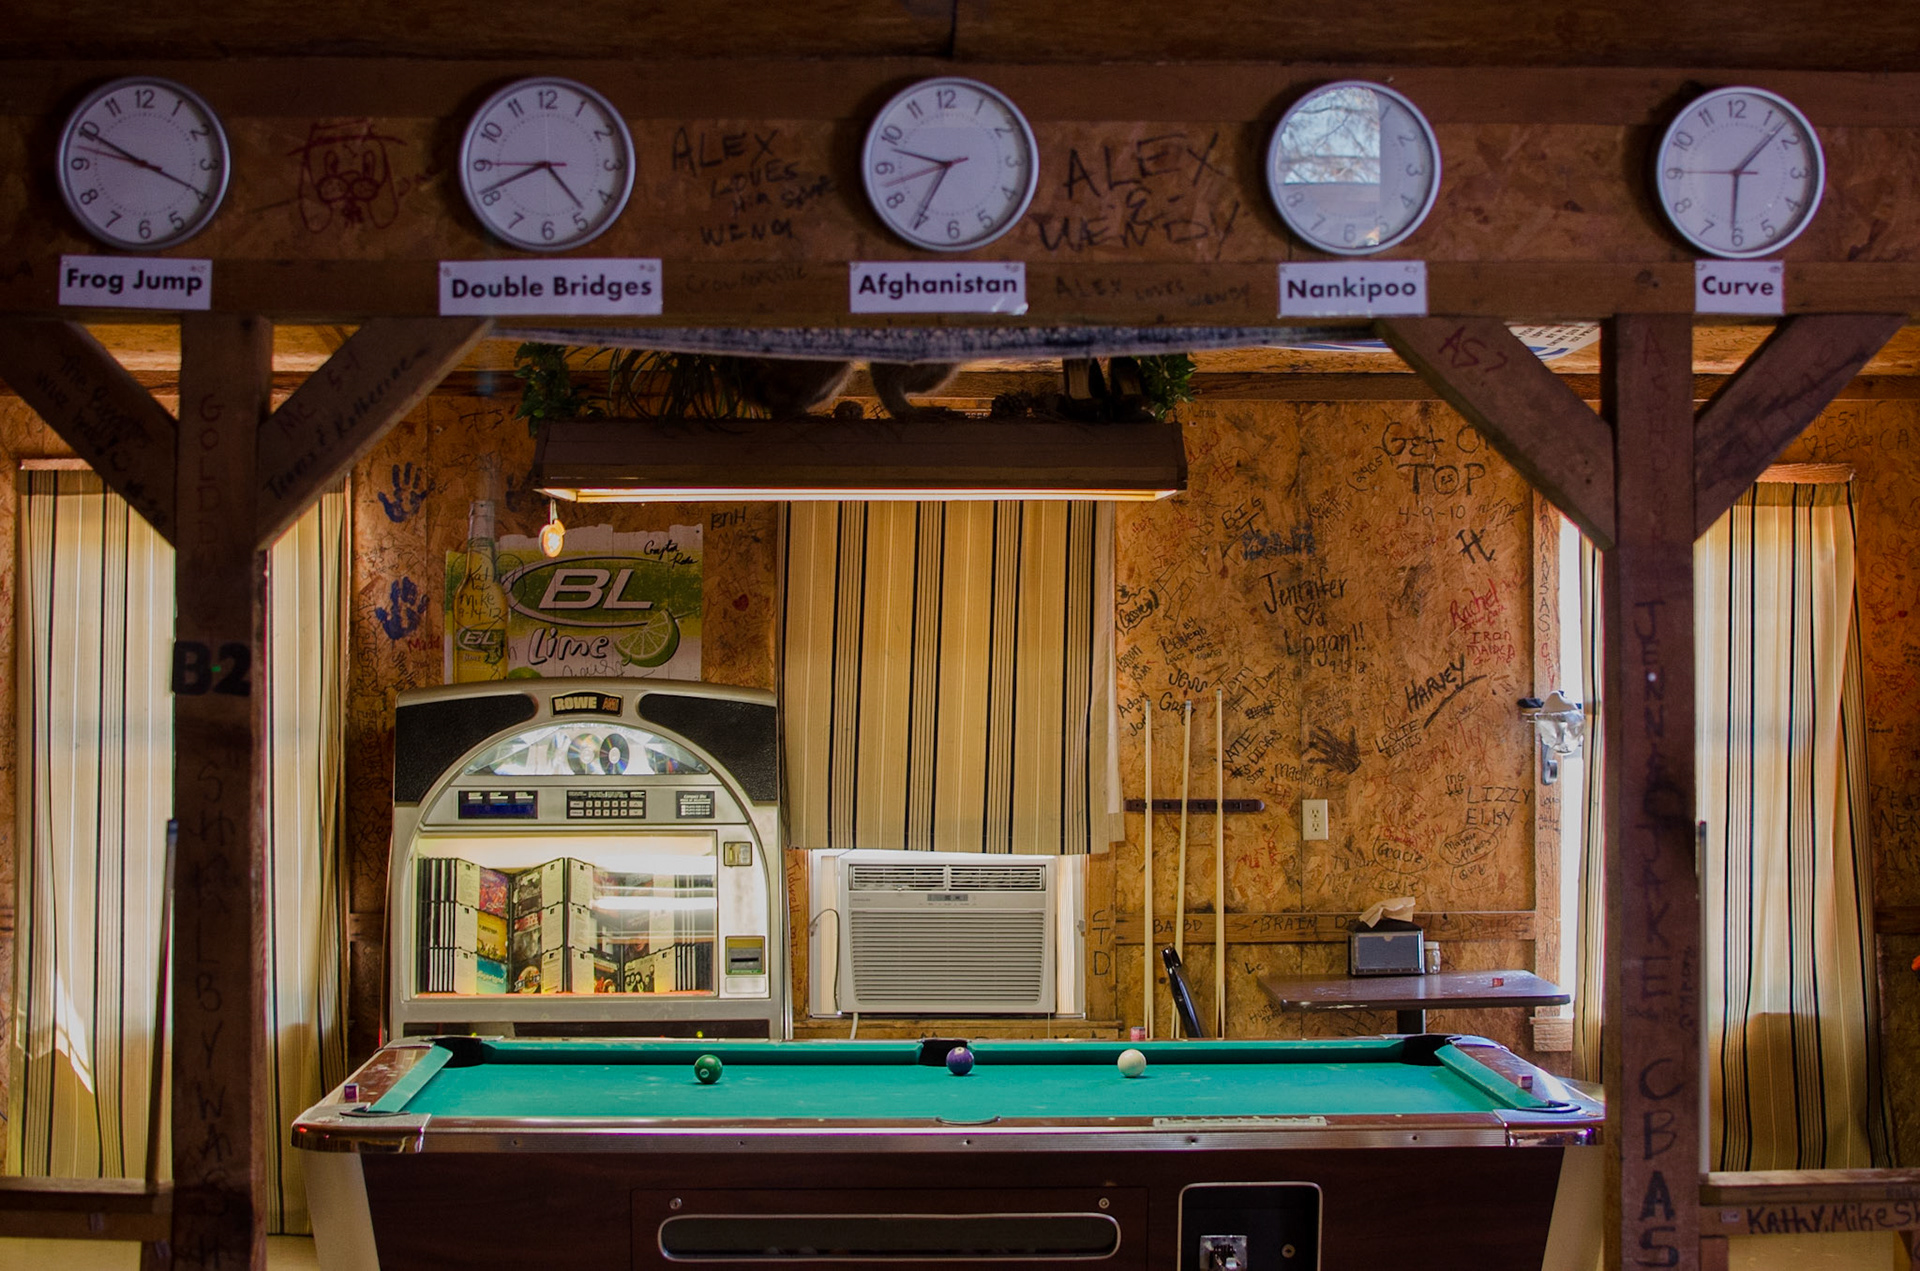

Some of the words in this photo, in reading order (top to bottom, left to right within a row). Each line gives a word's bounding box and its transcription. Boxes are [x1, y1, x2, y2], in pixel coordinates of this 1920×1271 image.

[671, 126, 778, 177] ALEX
[1062, 132, 1225, 199] ALEX
[66, 268, 124, 297] Frog
[134, 268, 204, 298] Jump
[451, 276, 544, 299] Double
[553, 276, 652, 303] Bridges
[858, 271, 1018, 299] Afghanistan
[1287, 275, 1418, 303] Nankipoo
[1701, 275, 1774, 296] Curve
[528, 627, 610, 666] Lime
[554, 696, 598, 711] ROWE
